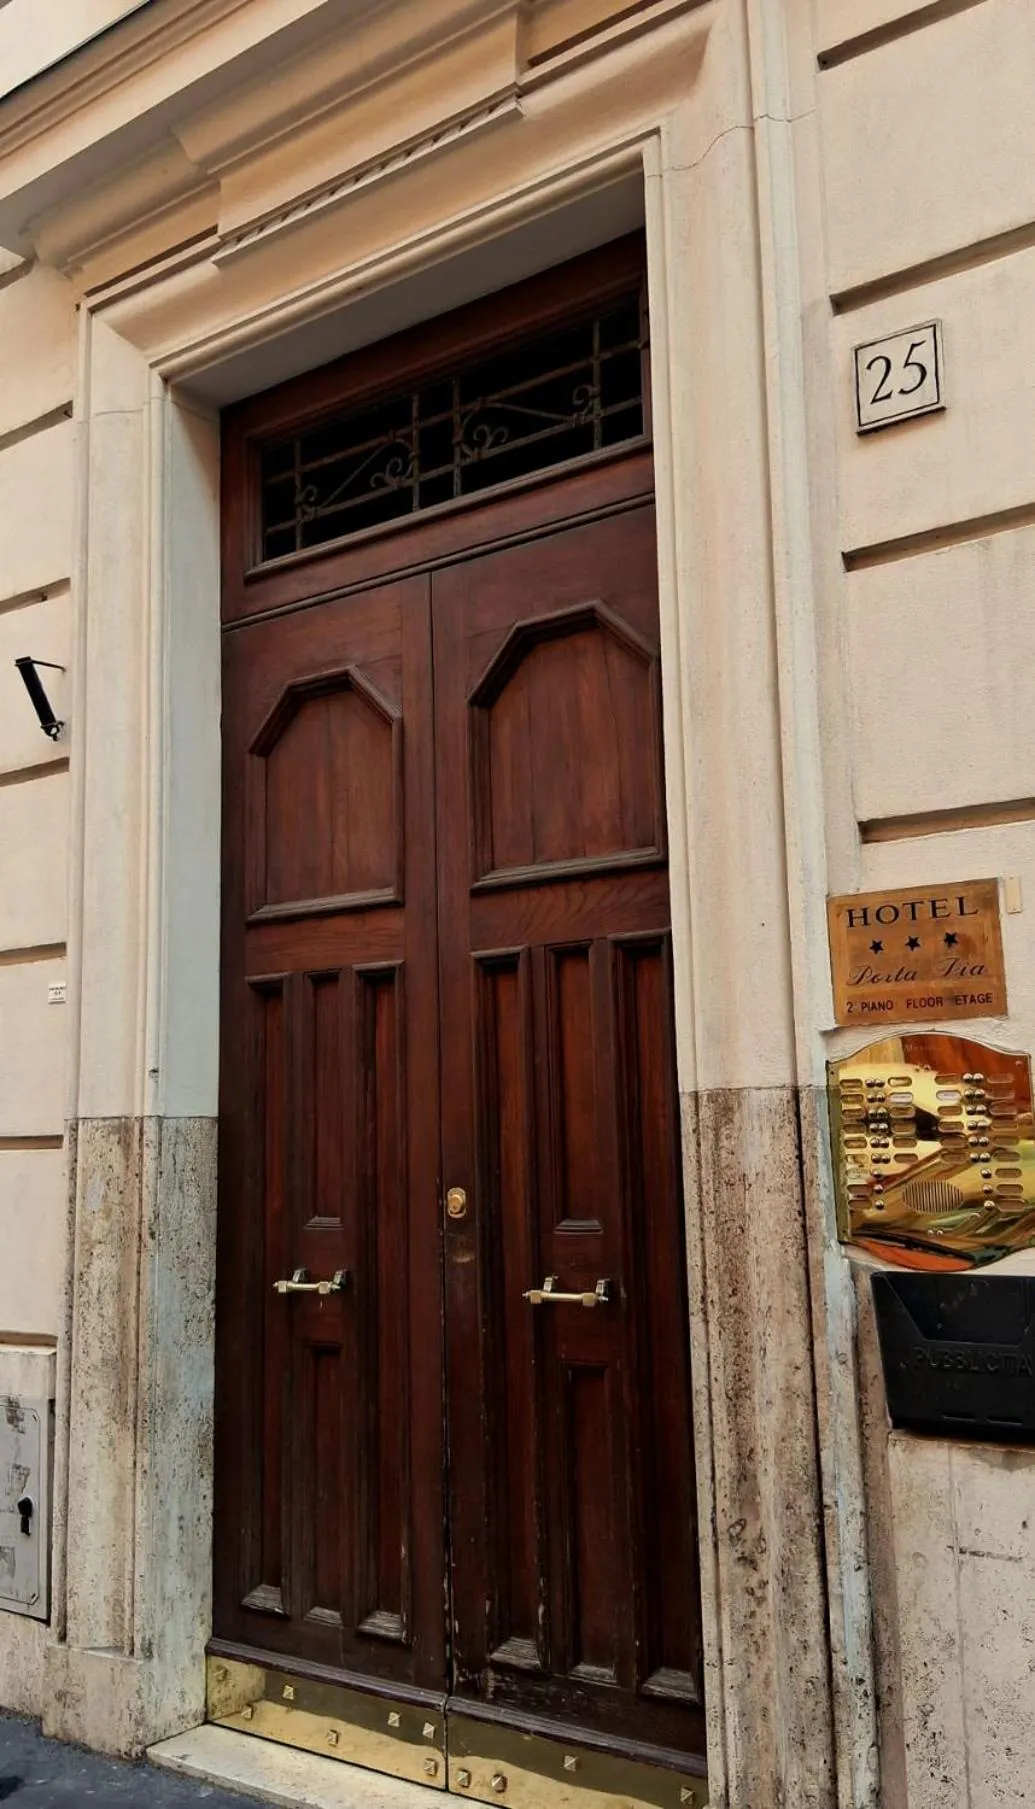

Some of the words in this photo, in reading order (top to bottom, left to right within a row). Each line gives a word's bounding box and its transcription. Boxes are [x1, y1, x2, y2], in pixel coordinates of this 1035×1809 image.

[866, 340, 927, 404] 25
[847, 896, 979, 927] HOTEL
[846, 964, 919, 986] Porta
[861, 1000, 894, 1012] PIANO
[906, 997, 944, 1009] FLOOR
[955, 992, 993, 1006] ETAGE
